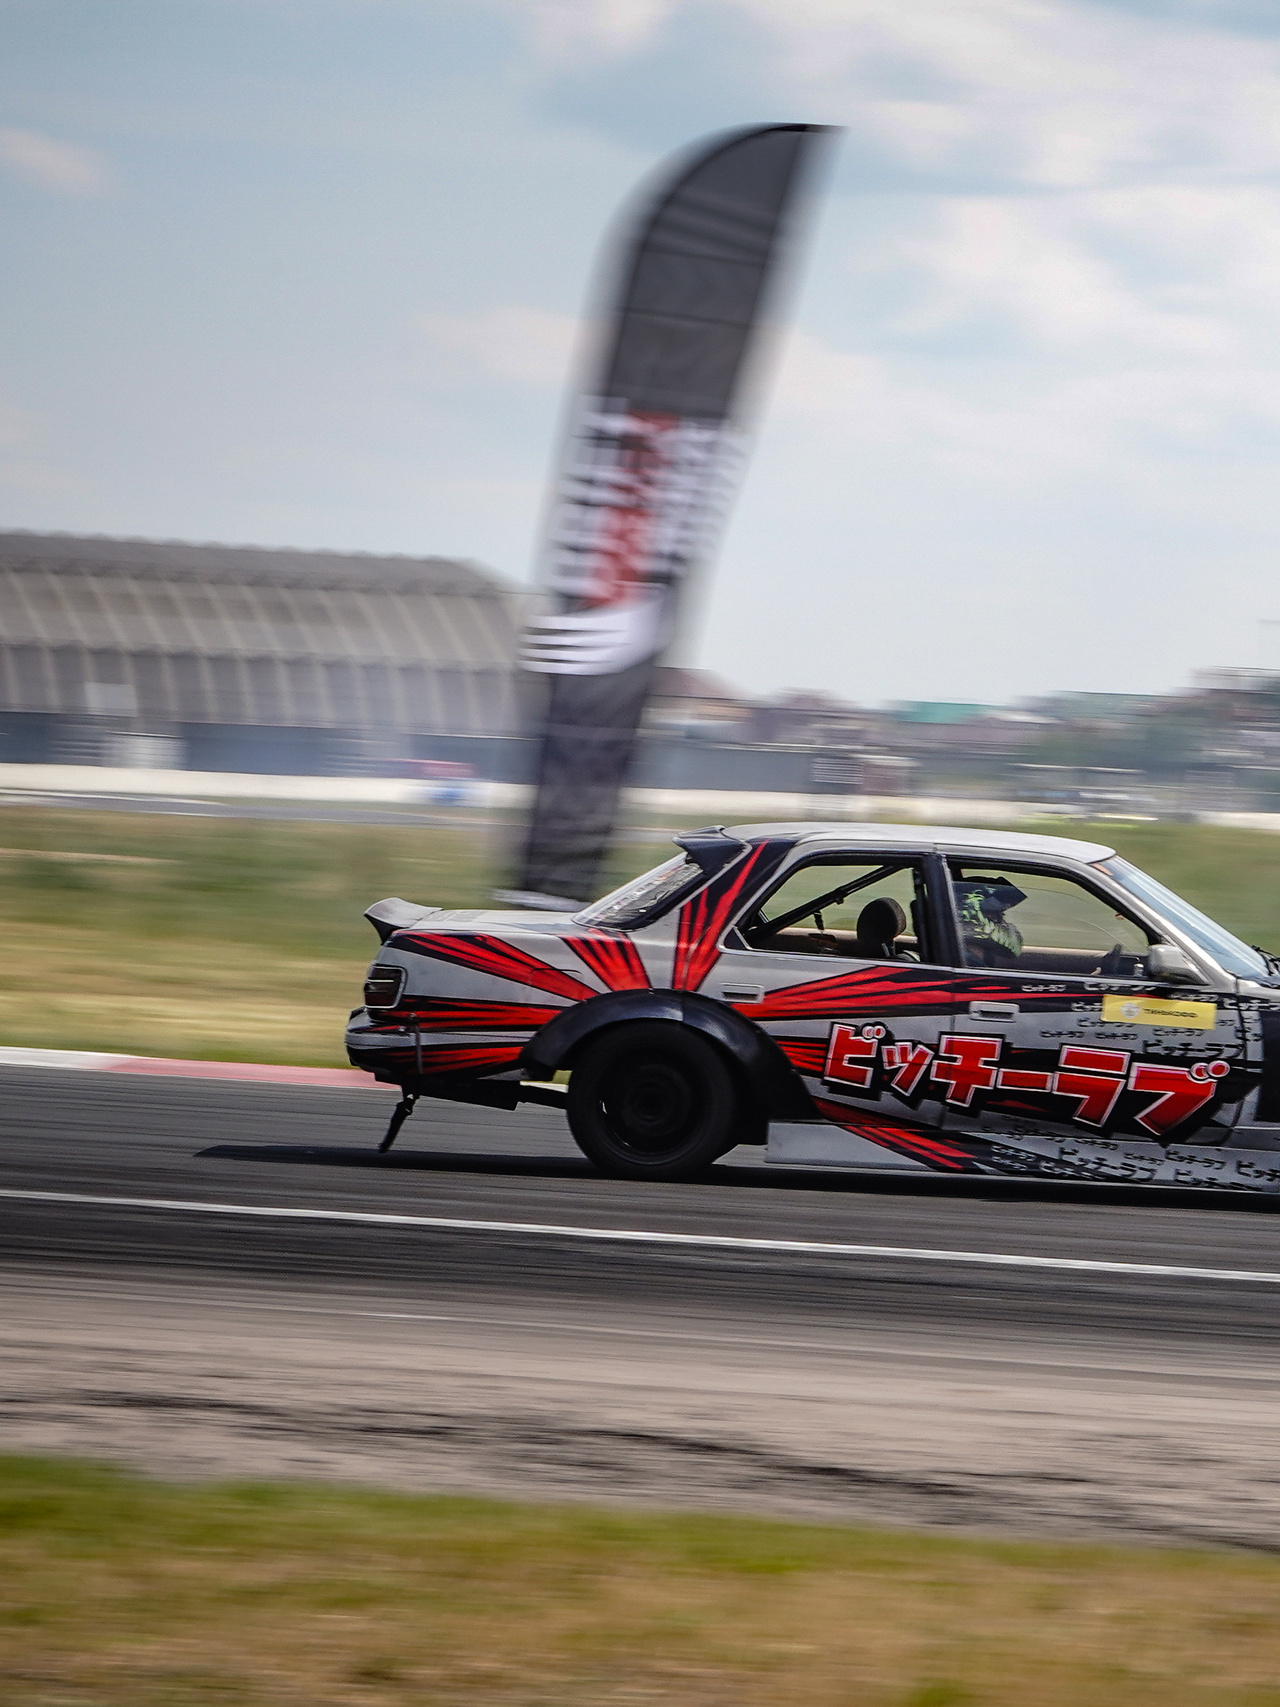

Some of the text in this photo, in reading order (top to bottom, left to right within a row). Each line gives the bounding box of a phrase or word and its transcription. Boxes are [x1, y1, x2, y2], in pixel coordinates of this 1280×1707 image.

[824, 1022, 1231, 1135] ビッチーラブ
